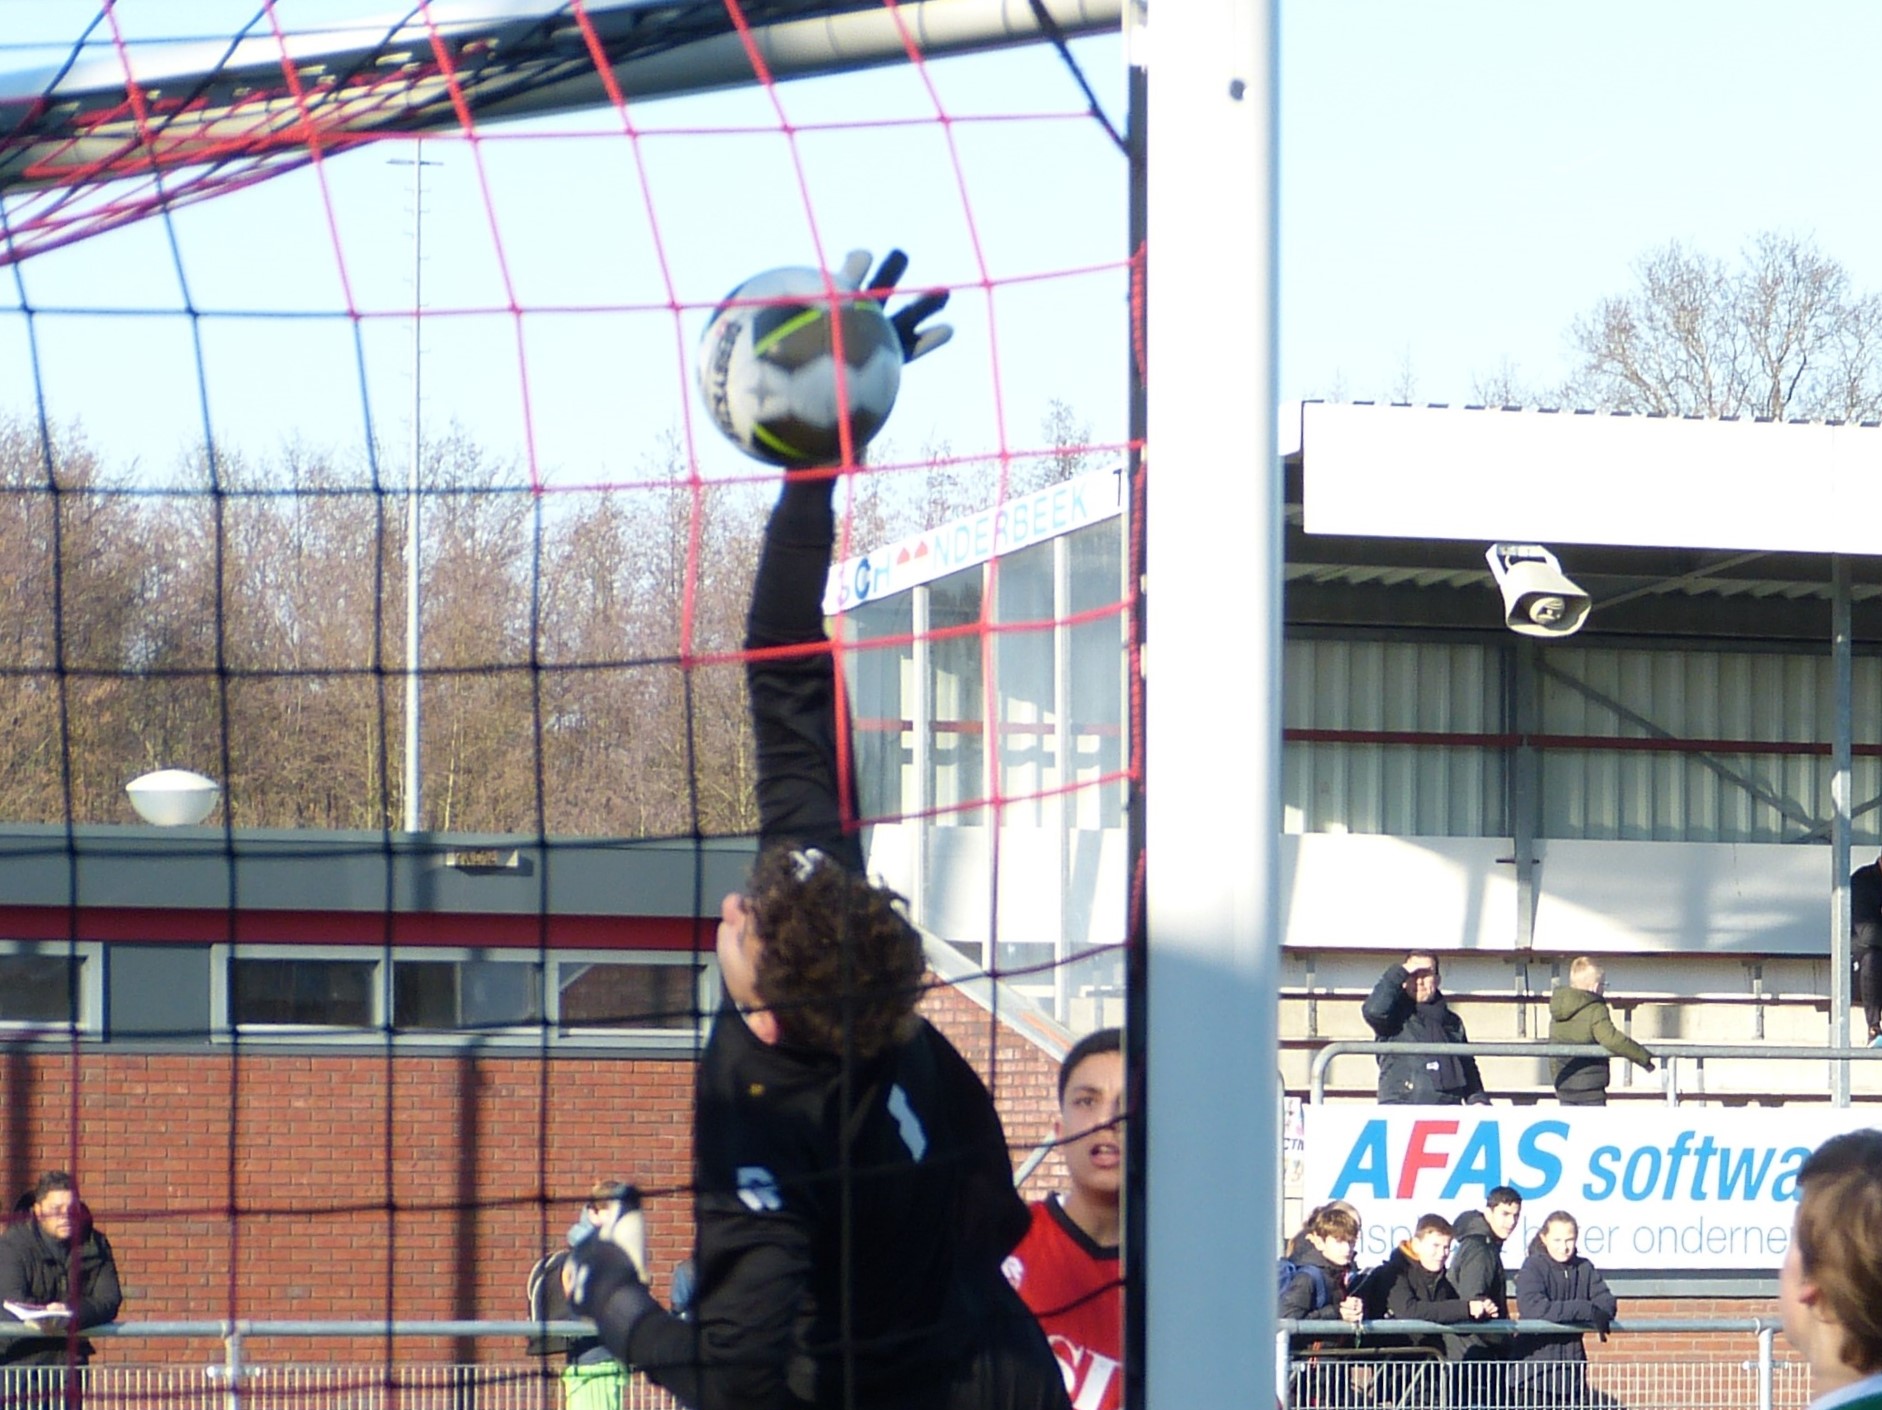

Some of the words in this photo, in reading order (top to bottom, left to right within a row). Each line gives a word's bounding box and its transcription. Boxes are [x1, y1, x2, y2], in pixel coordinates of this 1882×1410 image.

[1328, 1119, 1570, 1201] AFAS
[1582, 1130, 1814, 1202] softwa
[1633, 1216, 1792, 1255] onderne
